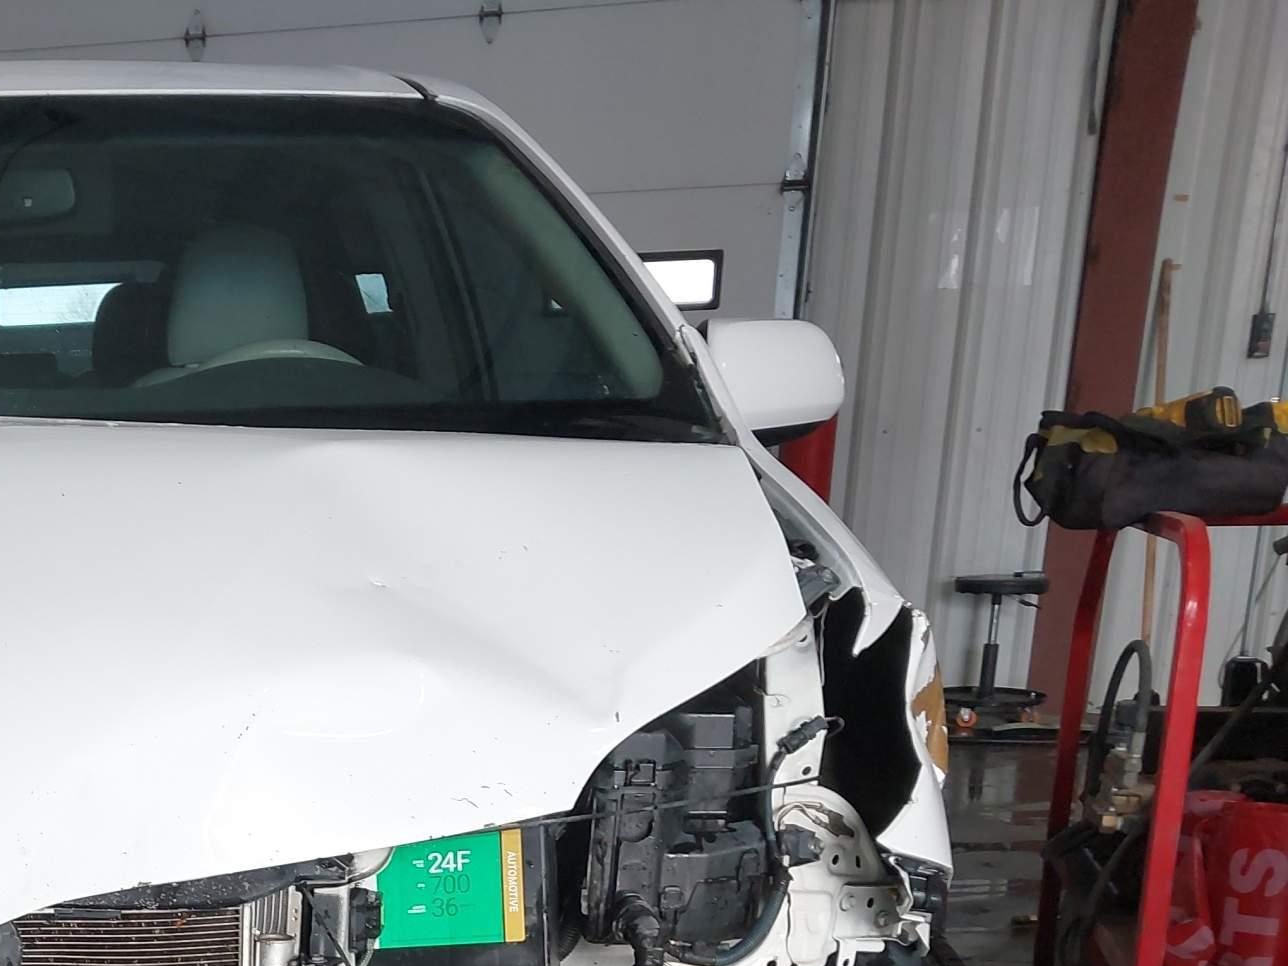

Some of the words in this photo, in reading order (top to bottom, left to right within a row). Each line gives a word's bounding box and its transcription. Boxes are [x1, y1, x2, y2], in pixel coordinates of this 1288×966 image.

[427, 850, 471, 874] 24F
[428, 873, 471, 895] 700
[507, 851, 519, 913] AUTOMOTIVE
[431, 897, 459, 917] 36
